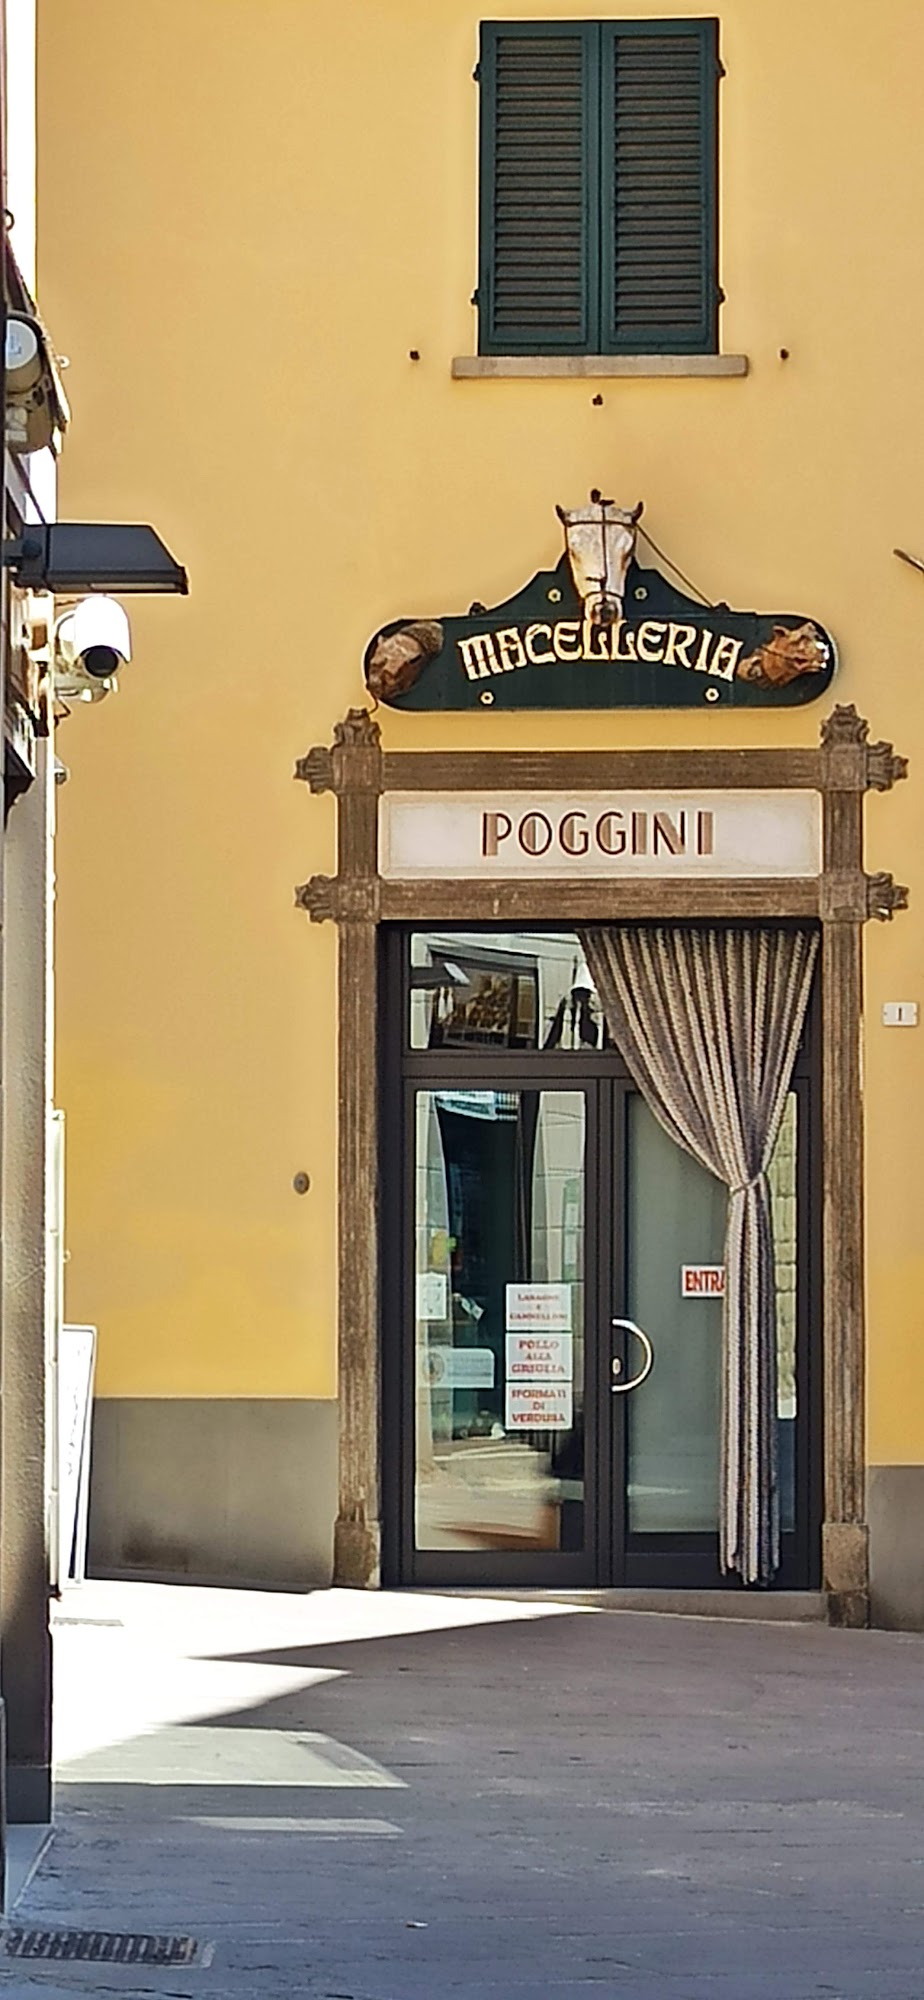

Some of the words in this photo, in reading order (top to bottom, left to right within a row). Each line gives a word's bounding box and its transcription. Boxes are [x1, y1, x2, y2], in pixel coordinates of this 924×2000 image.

[457, 619, 744, 682] MACELLERIA
[482, 810, 714, 857] POGGINI
[518, 1339, 560, 1350] POLLO
[532, 1401, 545, 1411] DI
